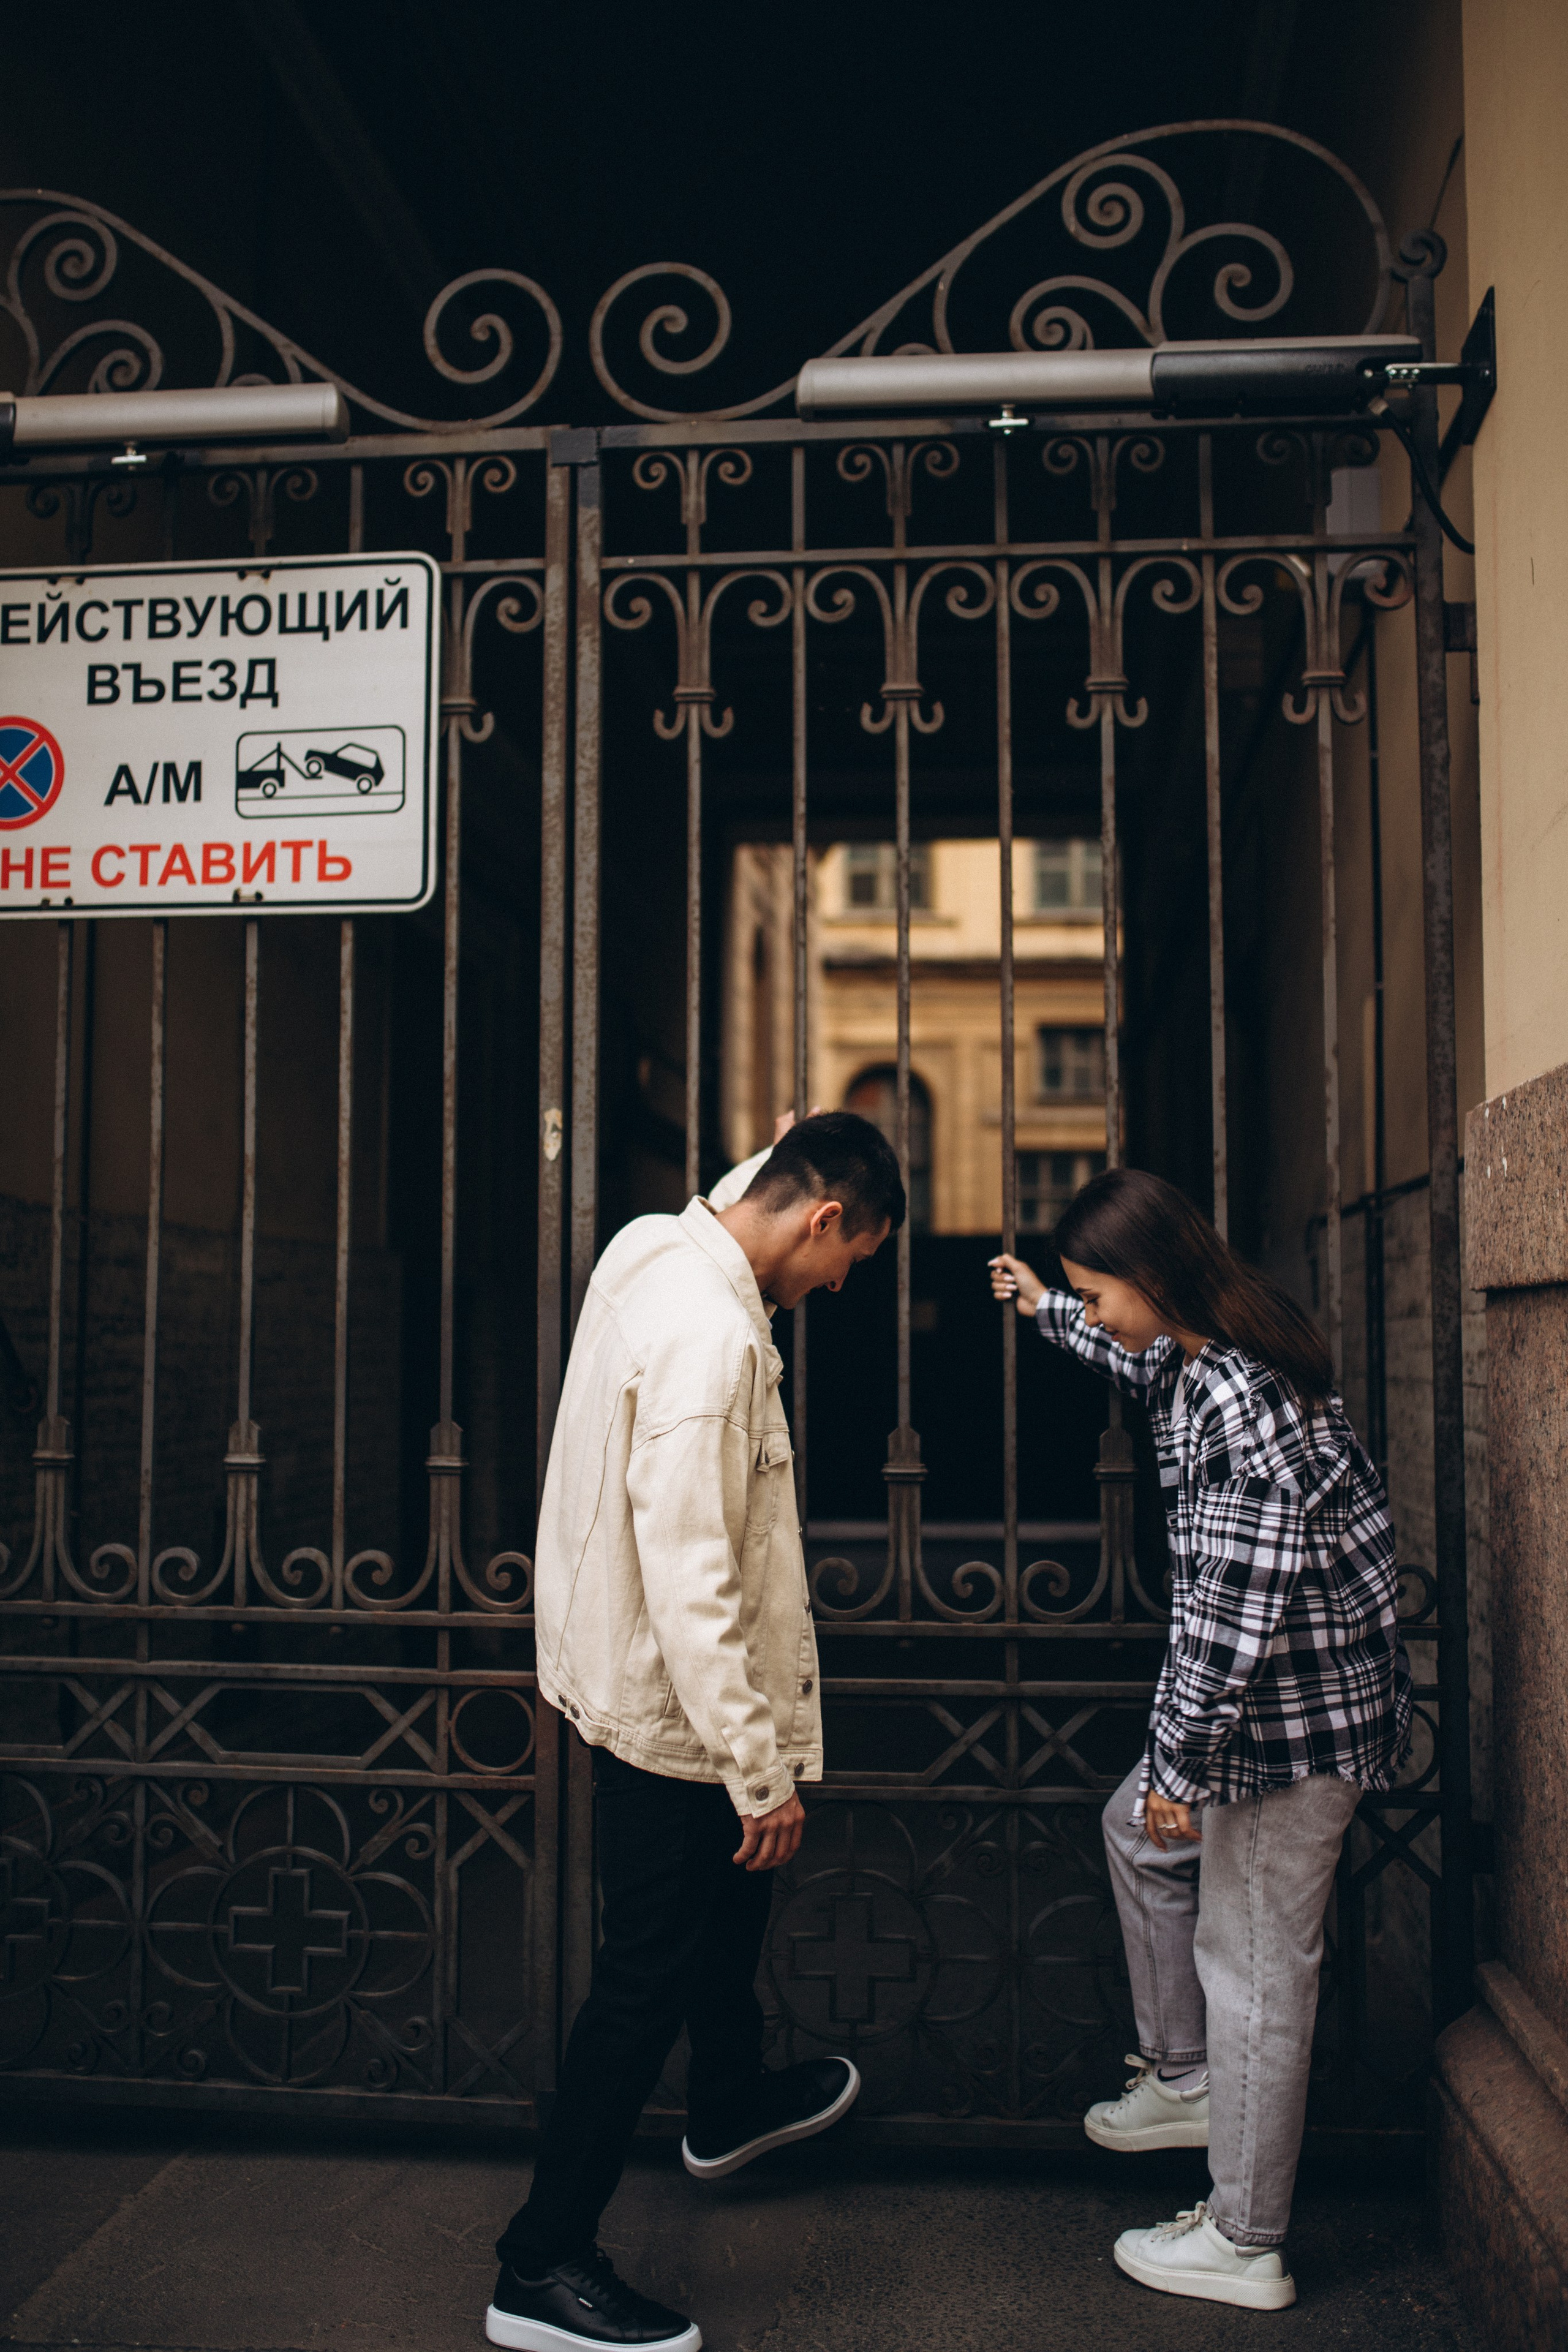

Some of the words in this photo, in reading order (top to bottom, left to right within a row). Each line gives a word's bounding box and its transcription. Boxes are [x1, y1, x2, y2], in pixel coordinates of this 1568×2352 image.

[1, 578, 408, 644] ЕЙСТВУЮЩИЙ
[88, 658, 278, 709] ВЪЕЗД
[104, 761, 201, 805] А/М
[1, 846, 70, 889] НЕ
[92, 840, 352, 888] СТАВИТЬ
